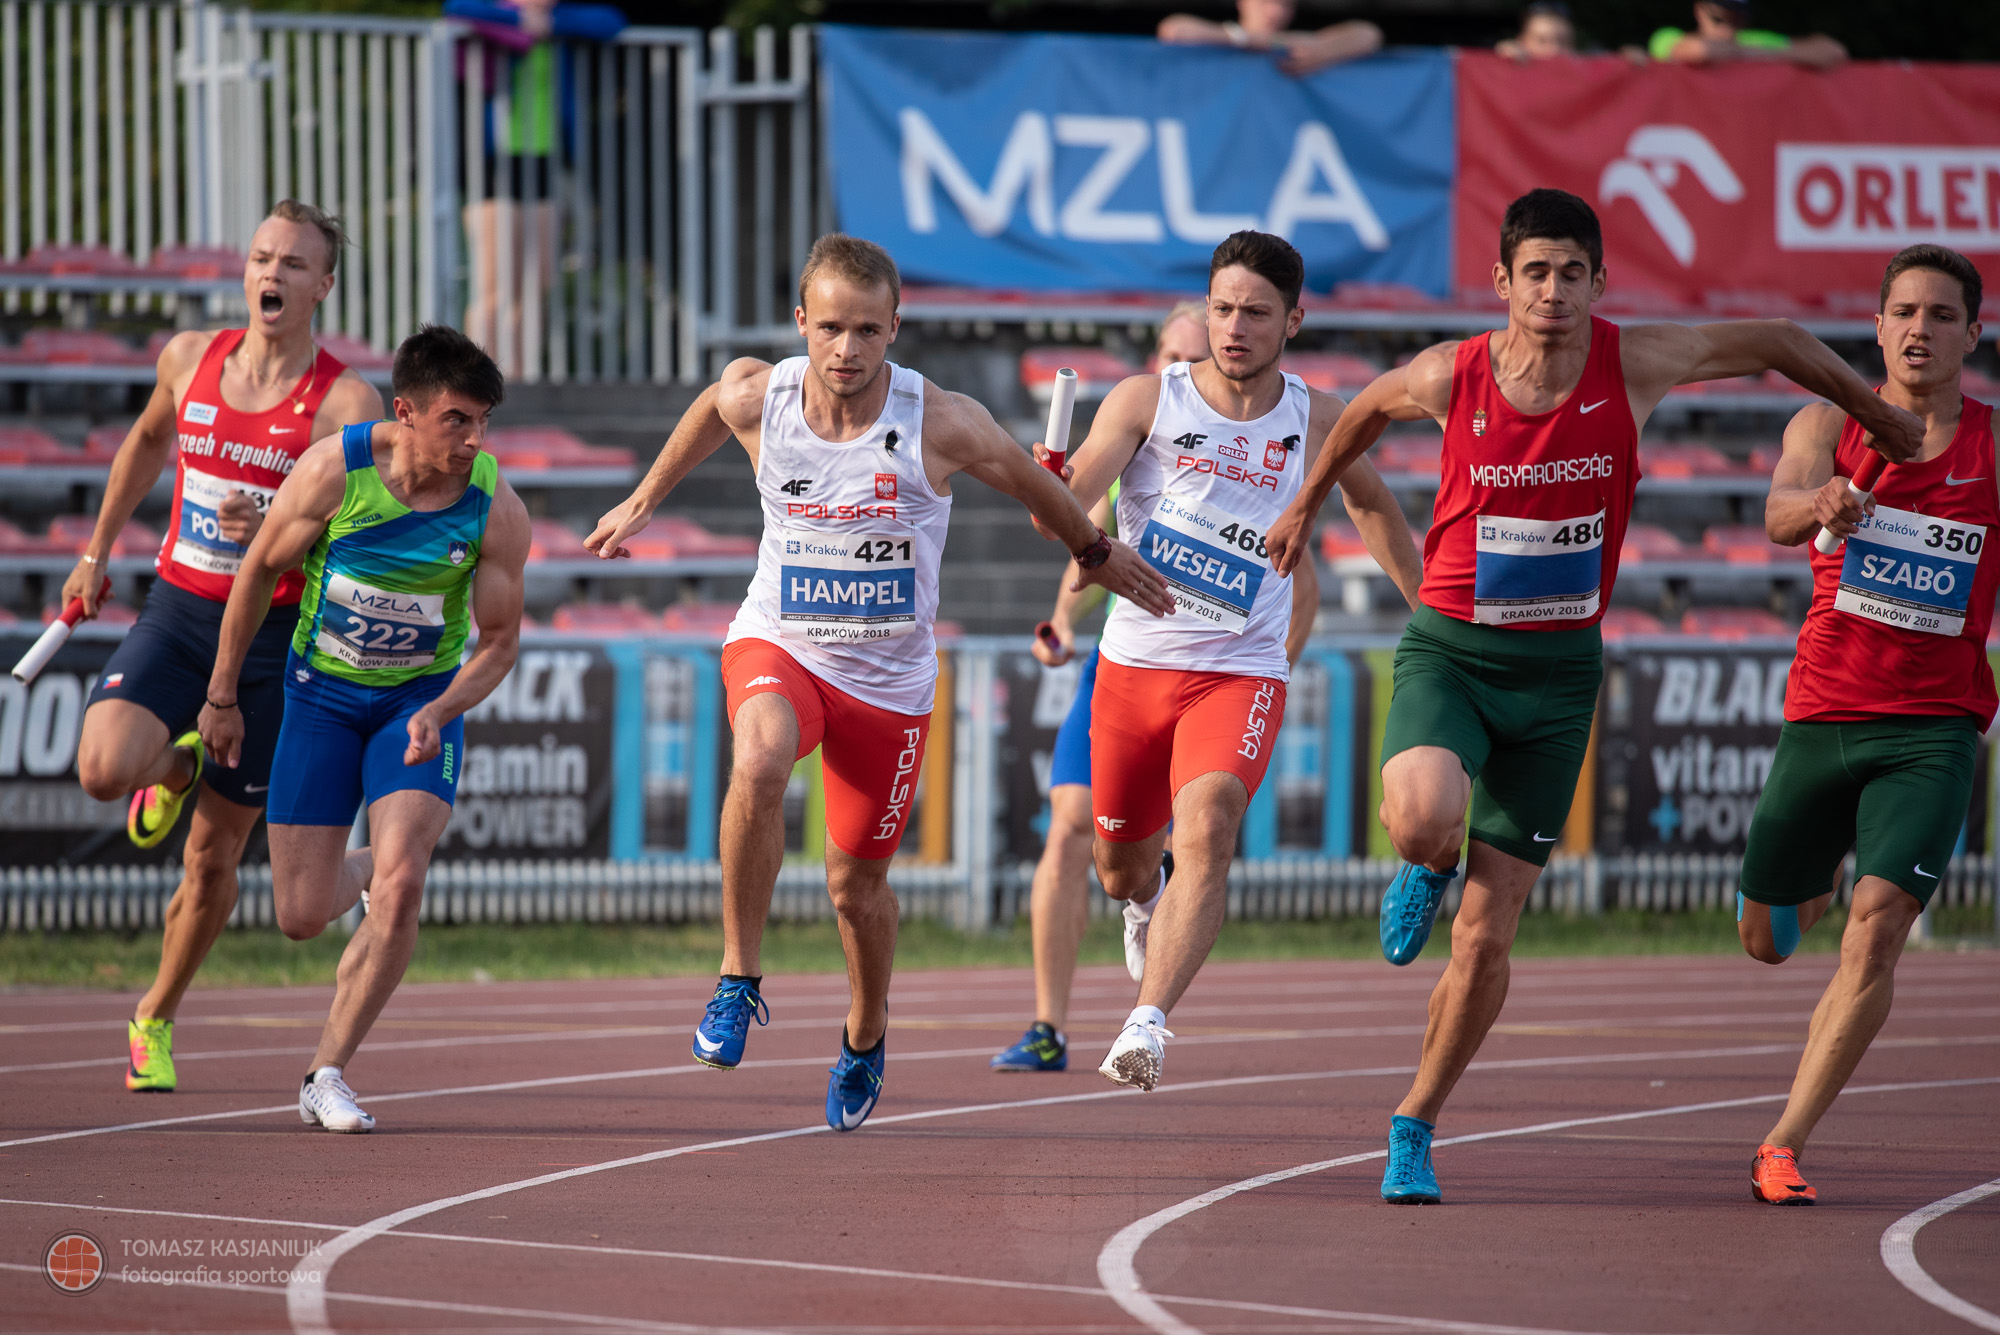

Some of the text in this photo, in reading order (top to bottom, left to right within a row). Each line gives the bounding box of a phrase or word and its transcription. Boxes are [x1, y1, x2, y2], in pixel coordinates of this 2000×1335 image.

[900, 107, 1390, 251] MZLA
[1173, 432, 1208, 449] 4F
[1219, 446, 1247, 461] ORLEN
[220, 440, 297, 476] republic
[1470, 453, 1613, 488] MAGYARORSZÁG
[780, 479, 813, 496] 4F
[1176, 455, 1278, 492] POLSKA
[787, 503, 897, 520] POLSKA
[1176, 506, 1269, 559] Kraków 468
[1501, 516, 1603, 546] Kraków 480
[1875, 519, 1983, 555] Kraków 350
[805, 540, 911, 563] Kraków 421
[1151, 533, 1248, 597] WESELA
[1860, 554, 1955, 595] SZABÓ
[352, 589, 423, 615] MZLA
[791, 577, 906, 605] HAMPEL
[1195, 605, 1222, 622] 2018
[1501, 605, 1587, 620] KRAKÓW 2018
[1860, 602, 1940, 629] KRAKÓW 2018
[344, 616, 419, 651] 222
[807, 626, 890, 638] KRAKÓW 2018
[338, 647, 411, 667] KRAKÓW 2018
[1237, 680, 1275, 760] POLSKA
[873, 727, 920, 840] POLSKA
